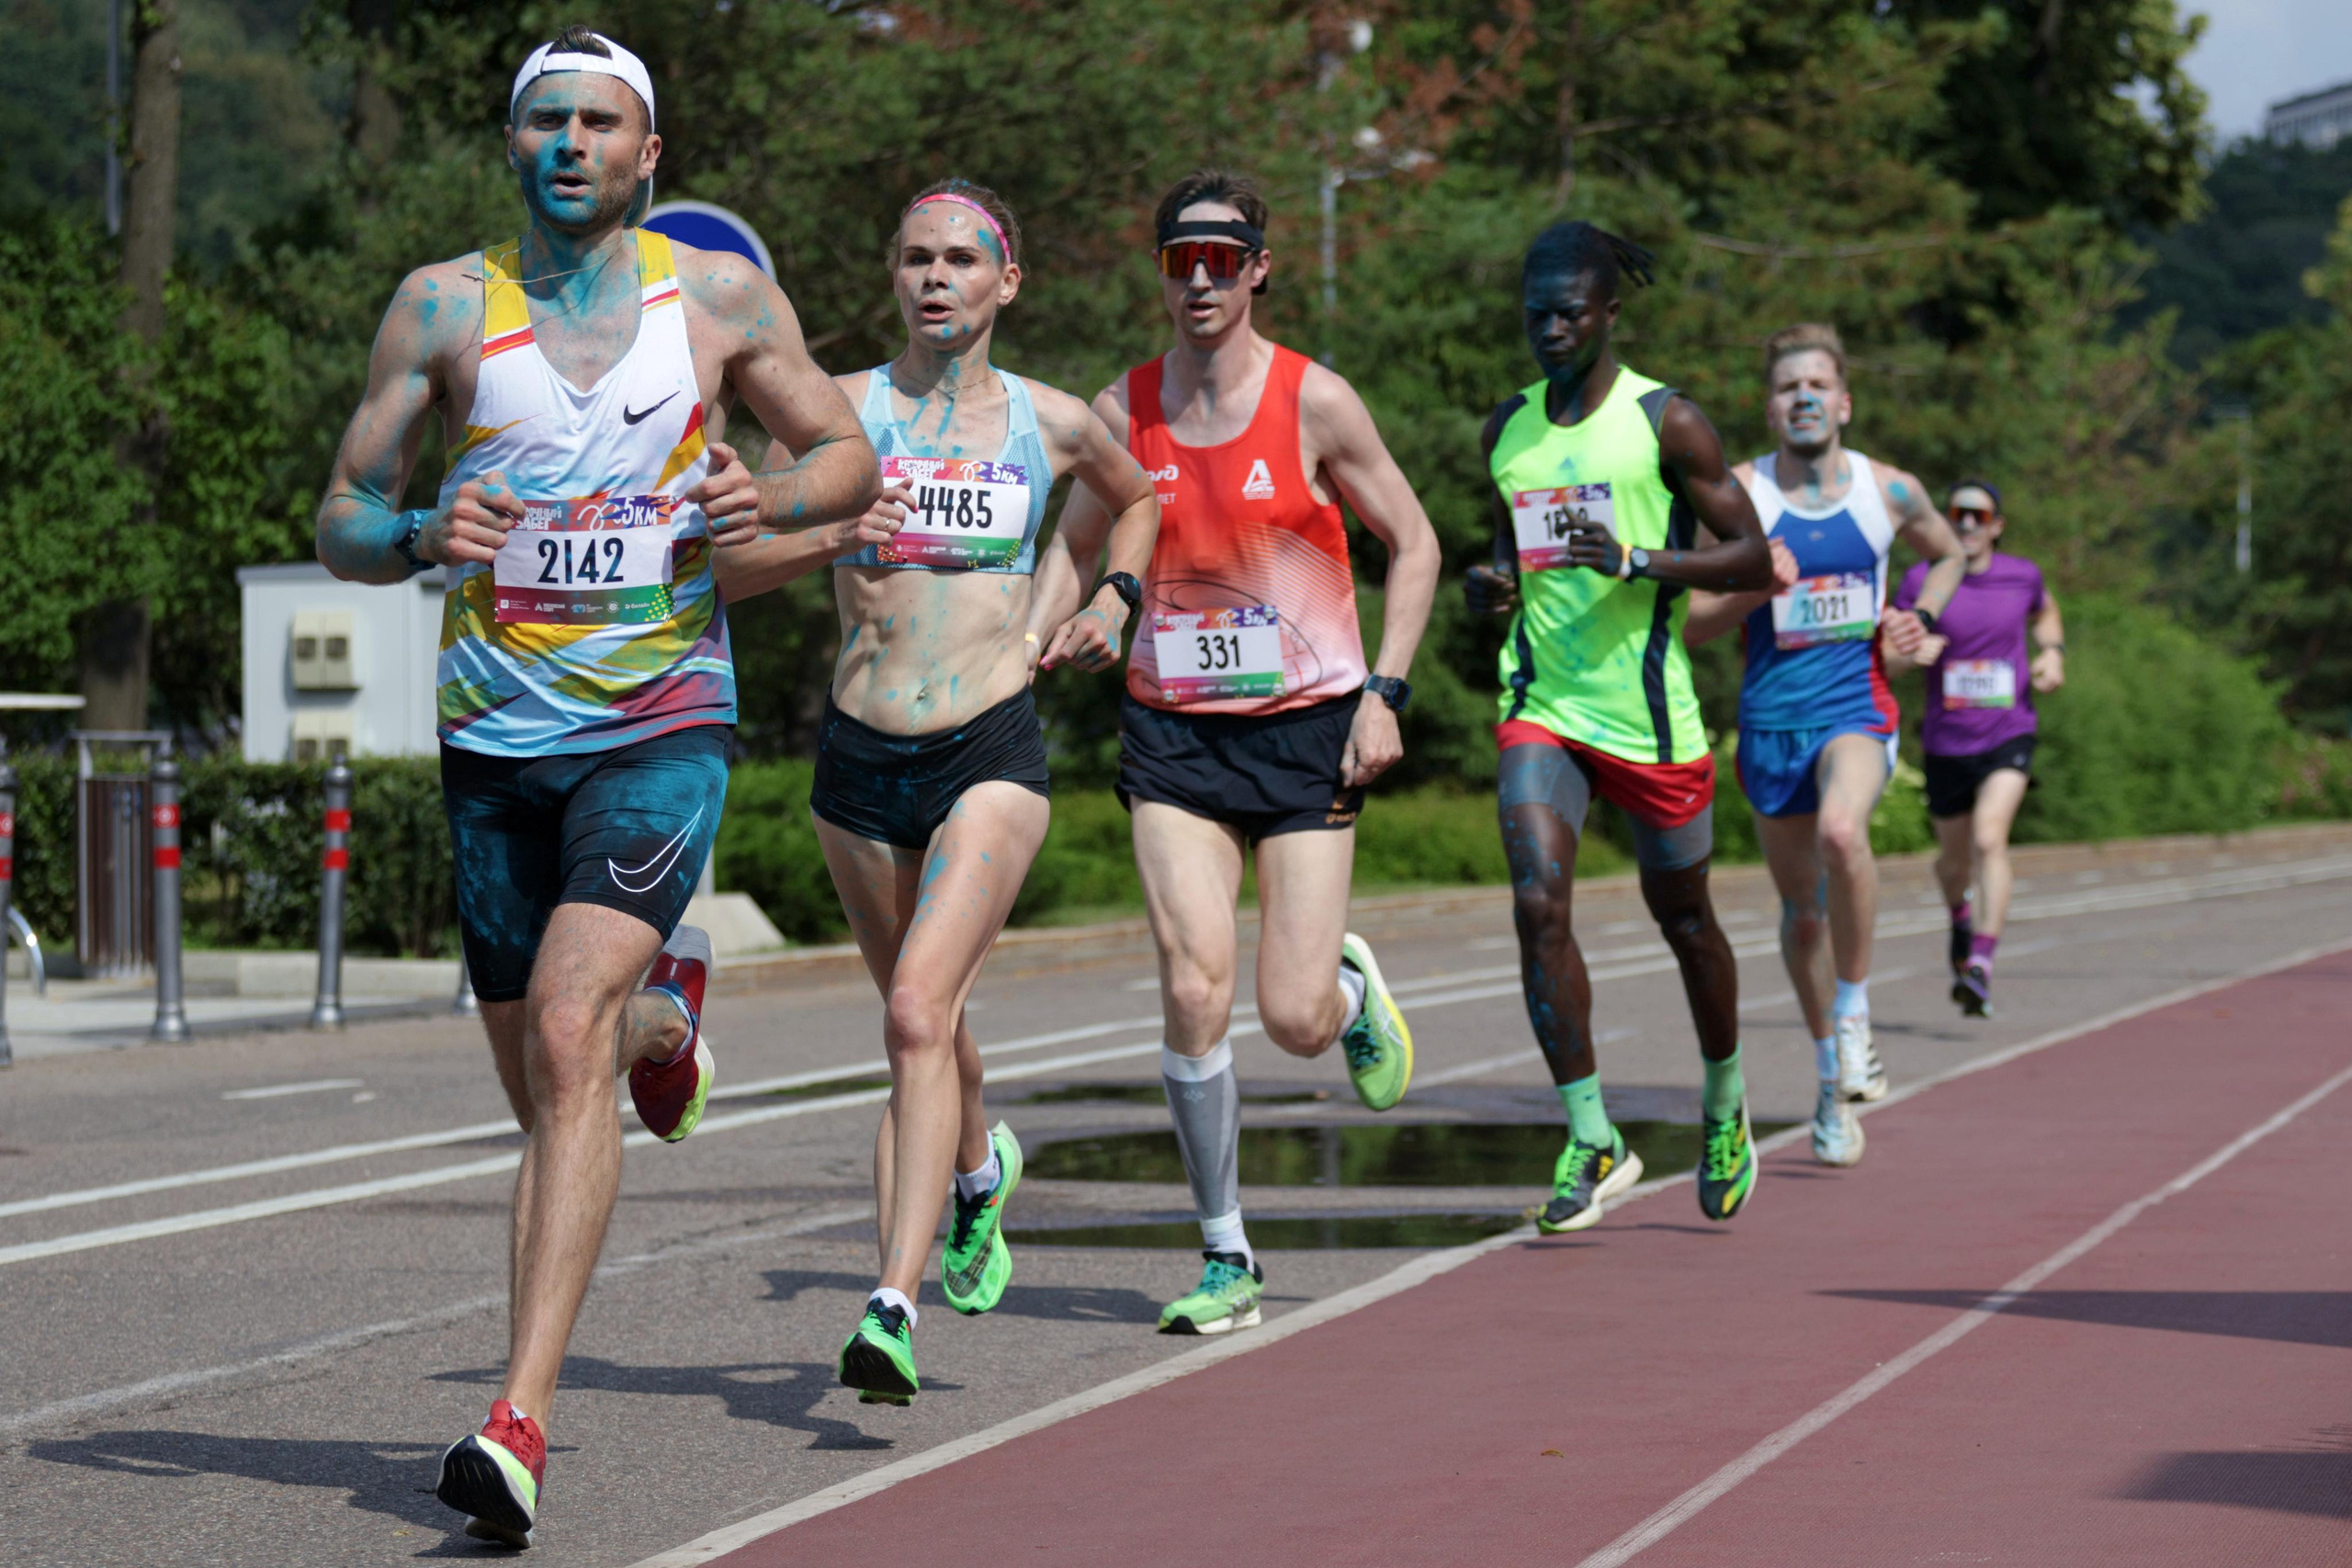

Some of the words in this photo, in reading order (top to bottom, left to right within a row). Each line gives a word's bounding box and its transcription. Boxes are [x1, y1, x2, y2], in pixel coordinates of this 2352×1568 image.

[918, 485, 992, 528] 4485
[537, 537, 624, 584] 2142
[1800, 594, 1849, 623] 2021
[1196, 635, 1240, 670] 331
